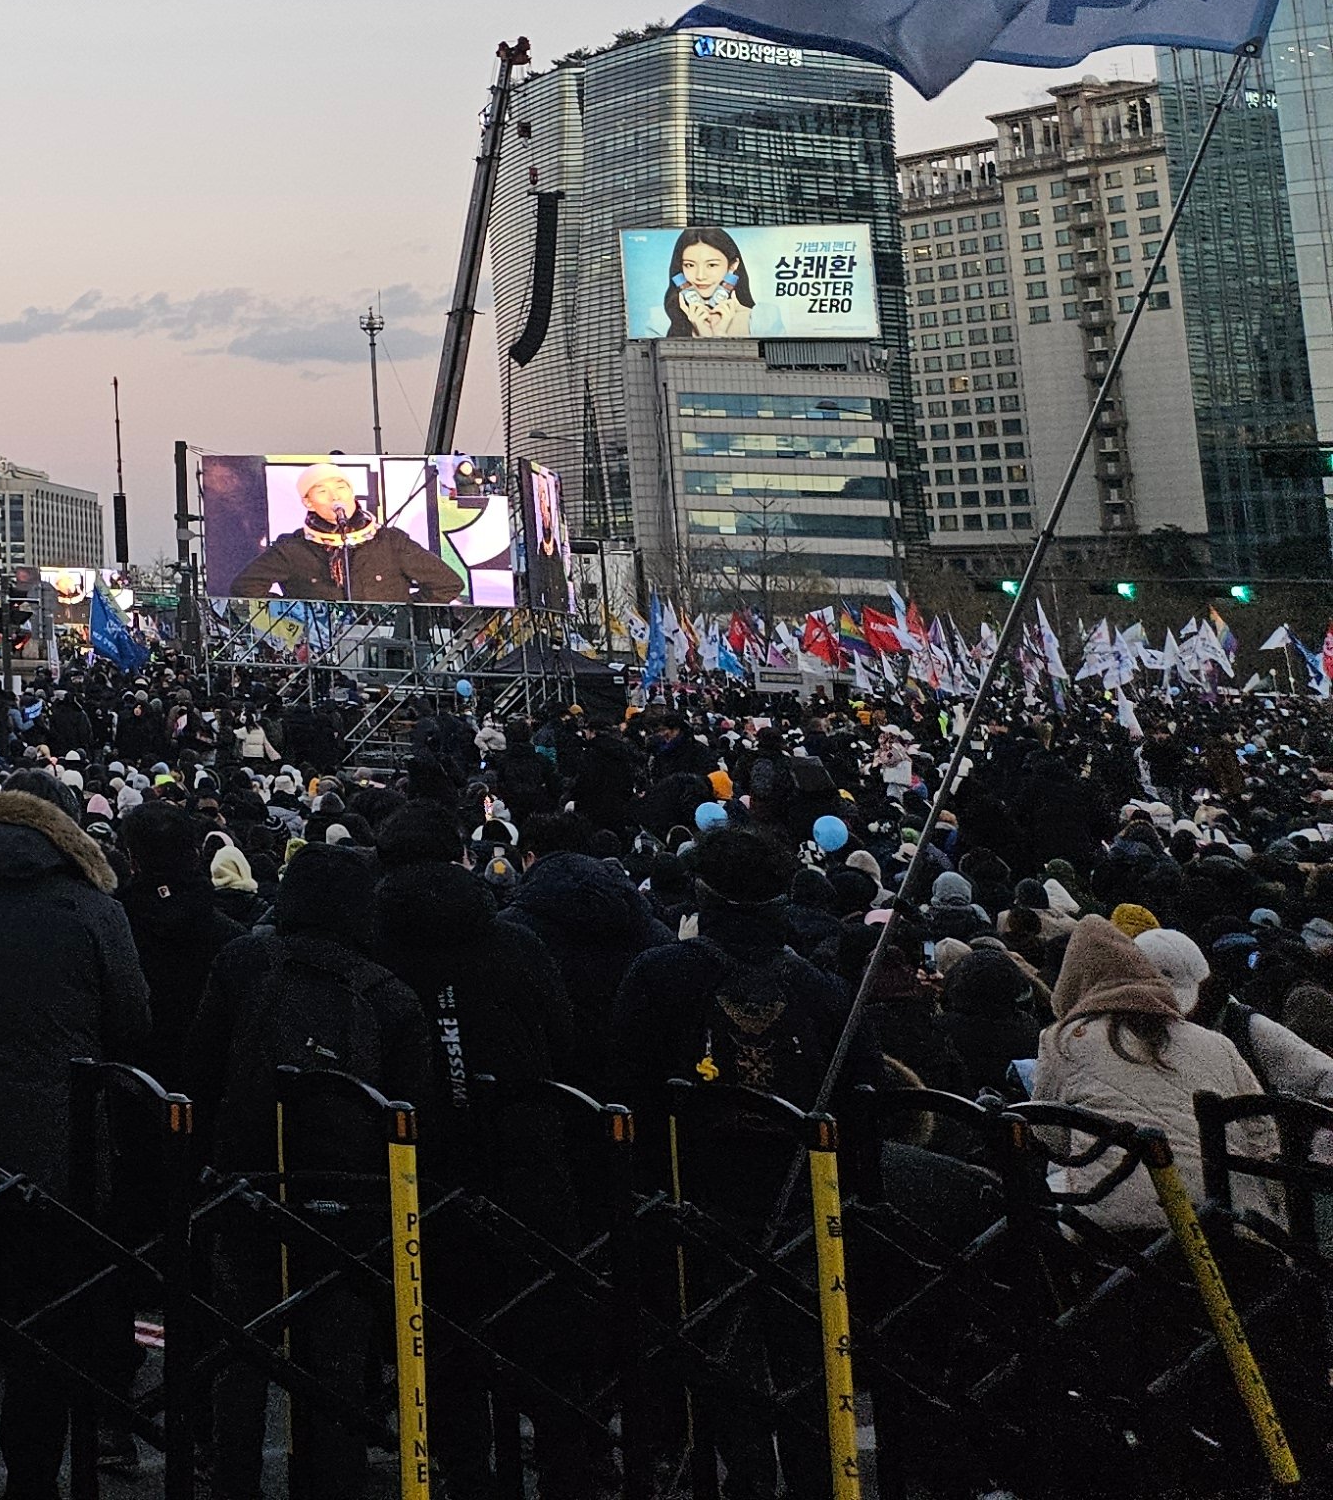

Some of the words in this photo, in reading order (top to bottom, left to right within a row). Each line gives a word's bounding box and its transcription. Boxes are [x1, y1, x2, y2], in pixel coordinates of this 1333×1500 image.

[714, 39, 804, 67] KDB산업은행
[795, 241, 830, 253] 가볍게
[775, 254, 857, 280] 상쾌환
[775, 281, 854, 297] BOOSTER
[808, 298, 852, 314] ZERO
[405, 1212, 423, 1357] POLICE
[414, 1389, 428, 1483] LINE
